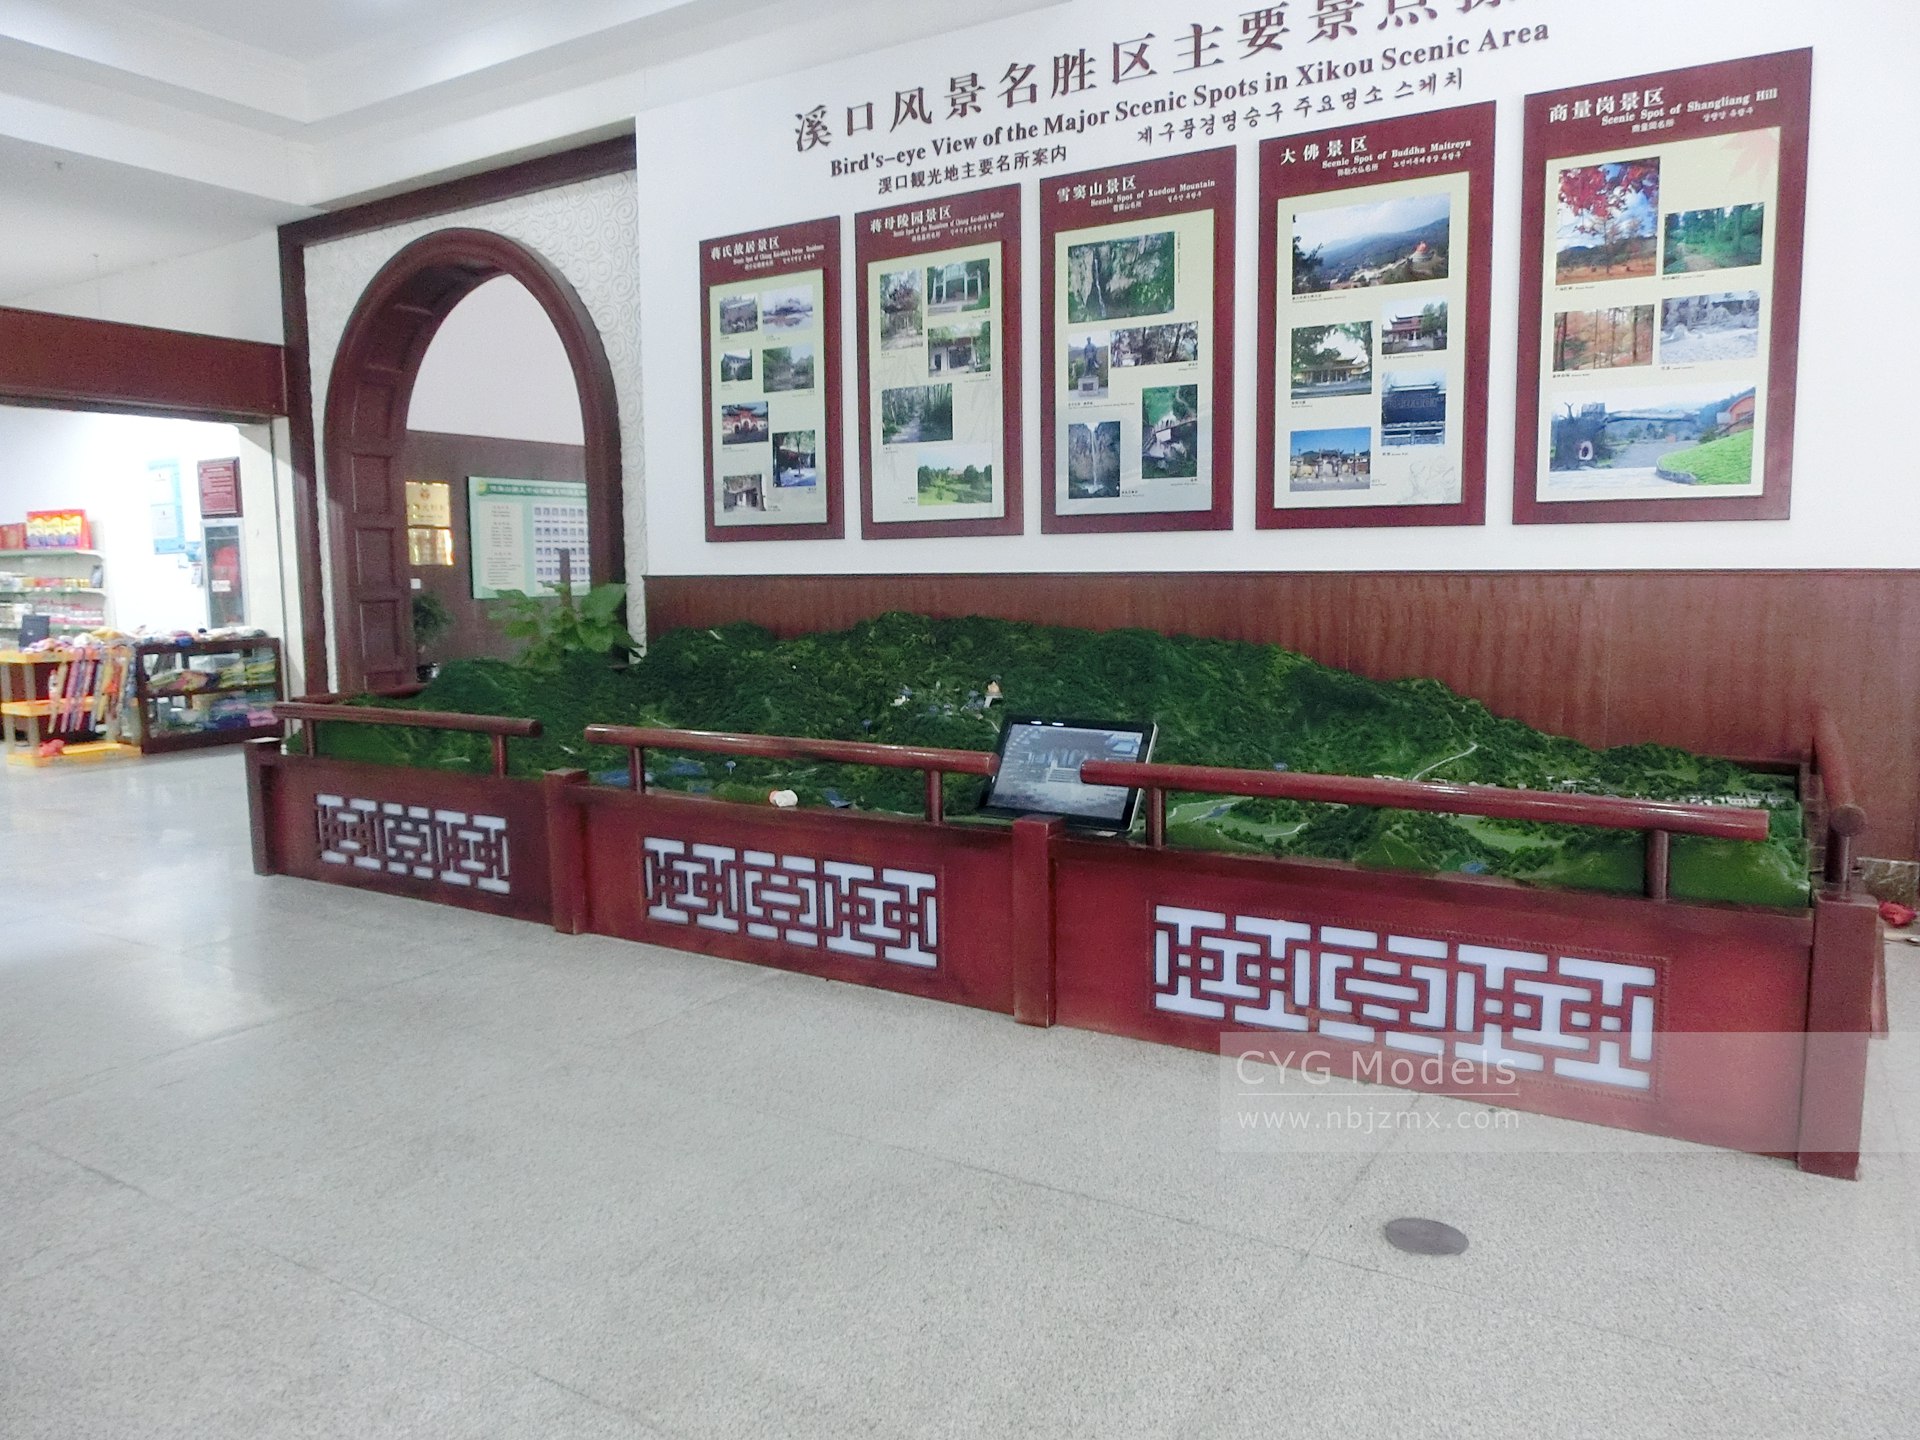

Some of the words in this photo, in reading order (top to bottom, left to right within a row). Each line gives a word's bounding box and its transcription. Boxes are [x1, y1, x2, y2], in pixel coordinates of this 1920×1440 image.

[932, 136, 978, 156] View
[983, 126, 1003, 146] of
[1008, 123, 1038, 142] the
[1044, 110, 1110, 135] Major
[1115, 91, 1187, 121] Scenic
[1193, 78, 1259, 108] Spots
[1265, 72, 1288, 92] in
[1296, 58, 1373, 87] Xikou
[1381, 35, 1470, 71] Scenic
[1478, 23, 1549, 52] Area
[1549, 87, 1665, 123] 商量岗景区
[1601, 113, 1636, 126] Scenic
[1640, 108, 1664, 121] Spot
[1670, 103, 1681, 115] of
[1687, 94, 1750, 112] Shangliang
[1756, 88, 1778, 101] Hill
[1280, 135, 1367, 165] 大佛景区
[1322, 158, 1349, 169] Scenic
[1353, 154, 1373, 166] Spot
[1377, 151, 1387, 160] of
[1391, 147, 1426, 158] Buddha
[1430, 139, 1471, 153] Maitreya
[1056, 174, 1137, 203] 雪窦山景区
[1090, 196, 1113, 207] Scenic
[1116, 193, 1133, 205] Spot
[1137, 191, 1144, 199] of
[1179, 179, 1216, 191] Mountain
